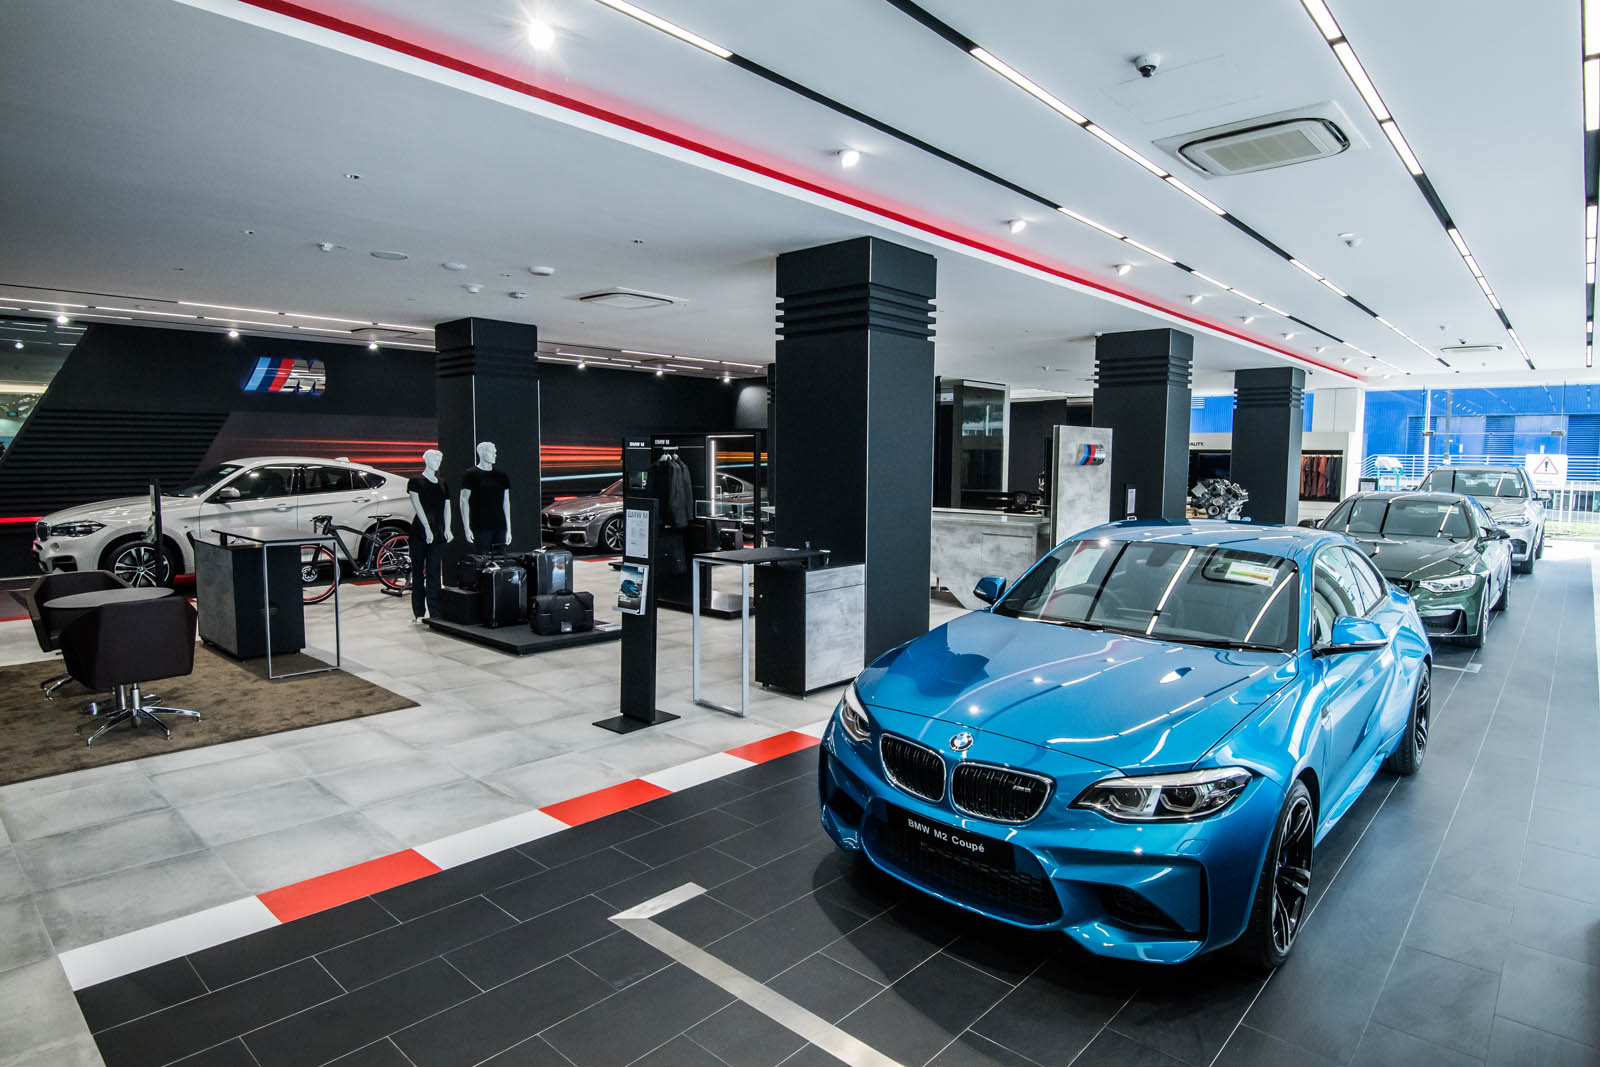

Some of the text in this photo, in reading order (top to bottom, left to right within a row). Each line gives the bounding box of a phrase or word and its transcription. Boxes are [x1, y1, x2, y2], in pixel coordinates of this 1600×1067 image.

[907, 818, 985, 853] BMW M2 Coupé
